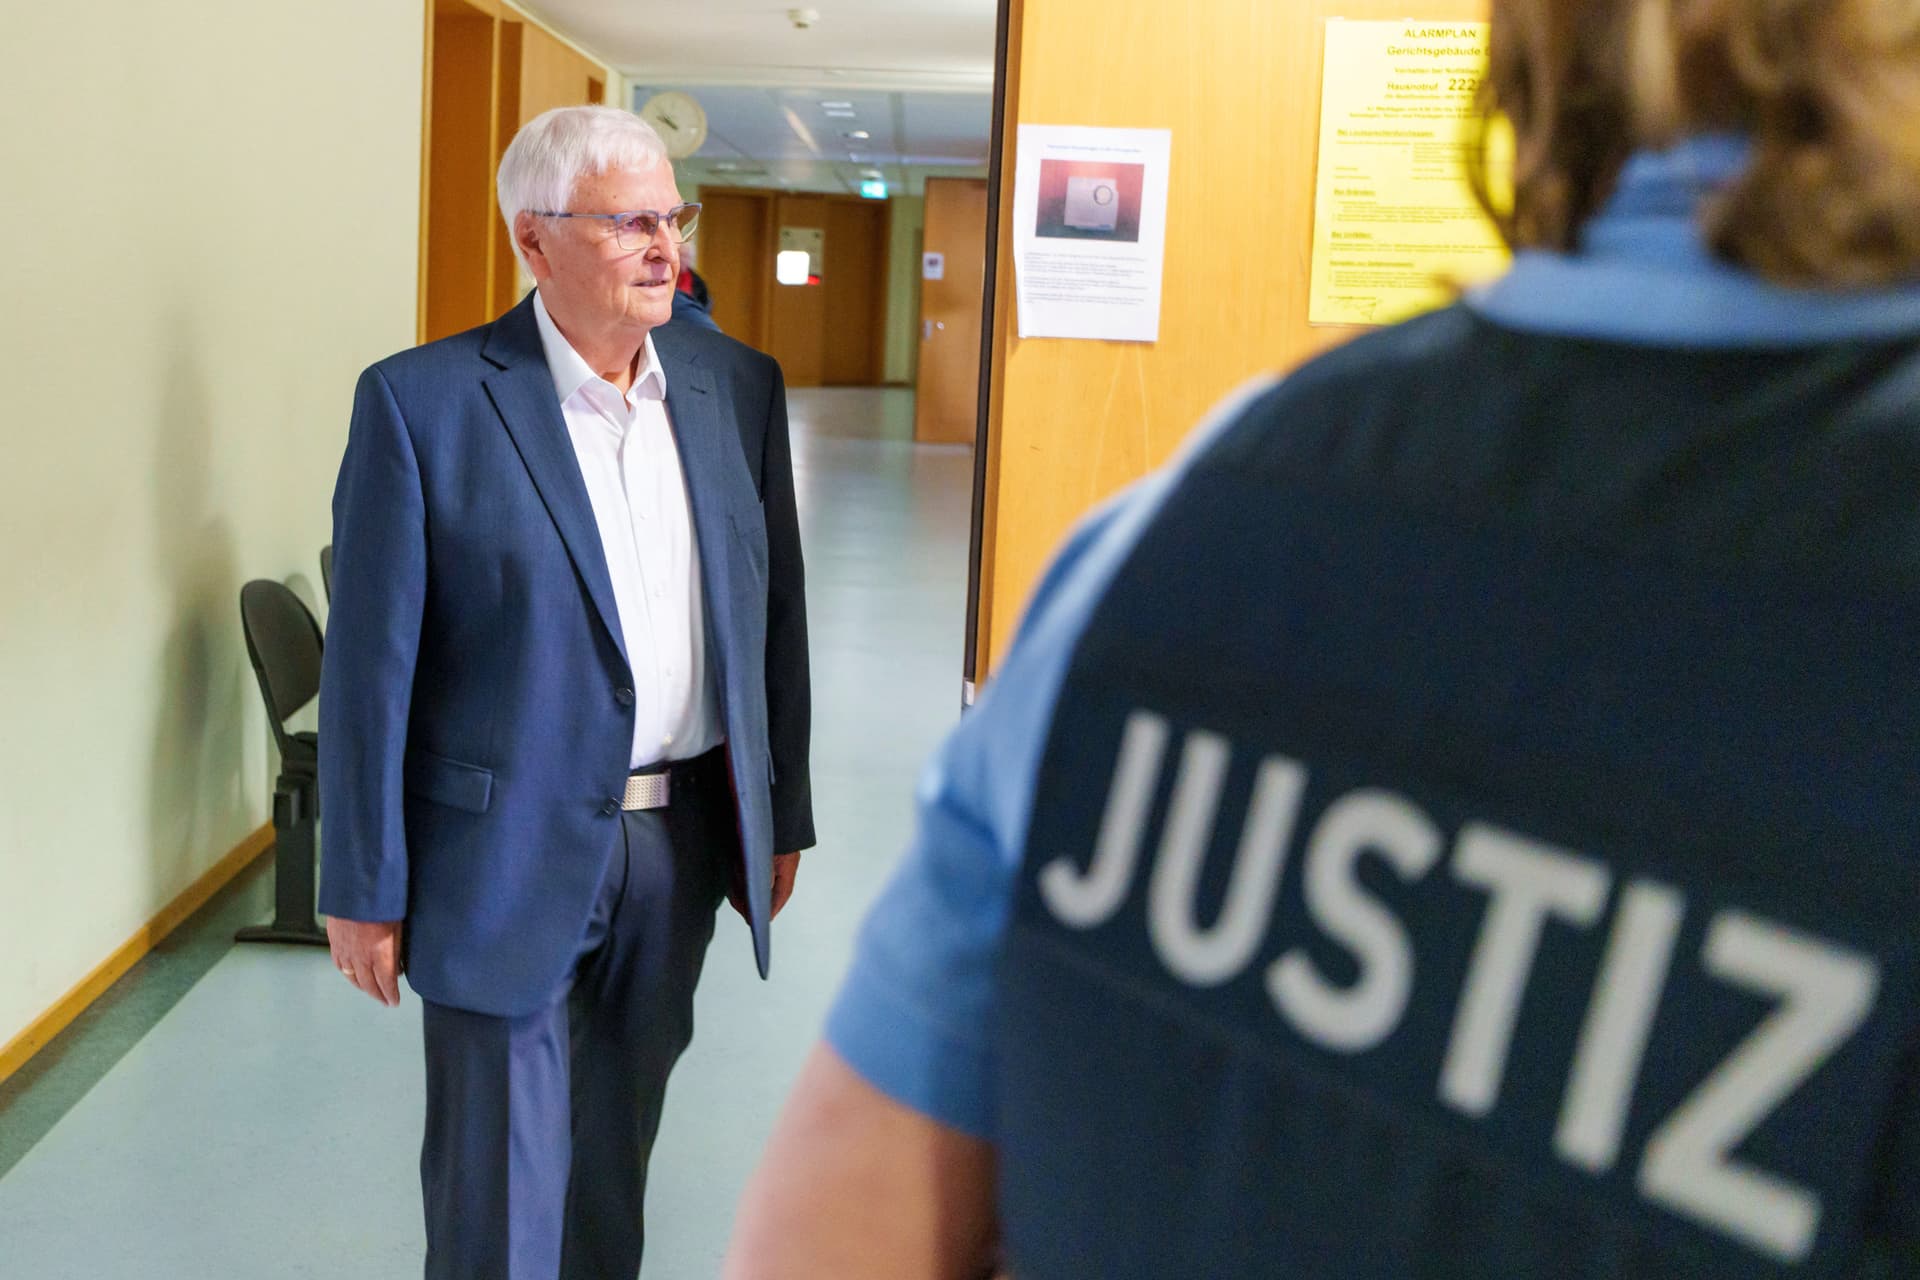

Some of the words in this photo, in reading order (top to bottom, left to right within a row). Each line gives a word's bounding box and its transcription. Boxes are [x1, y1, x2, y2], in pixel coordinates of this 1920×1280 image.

[1404, 29, 1477, 38] ALARMPLAN
[1386, 45, 1481, 58] Gerichtsgebäude
[1386, 81, 1439, 91] Hausnotruf
[1039, 709, 1880, 1262] JUSTIZ
